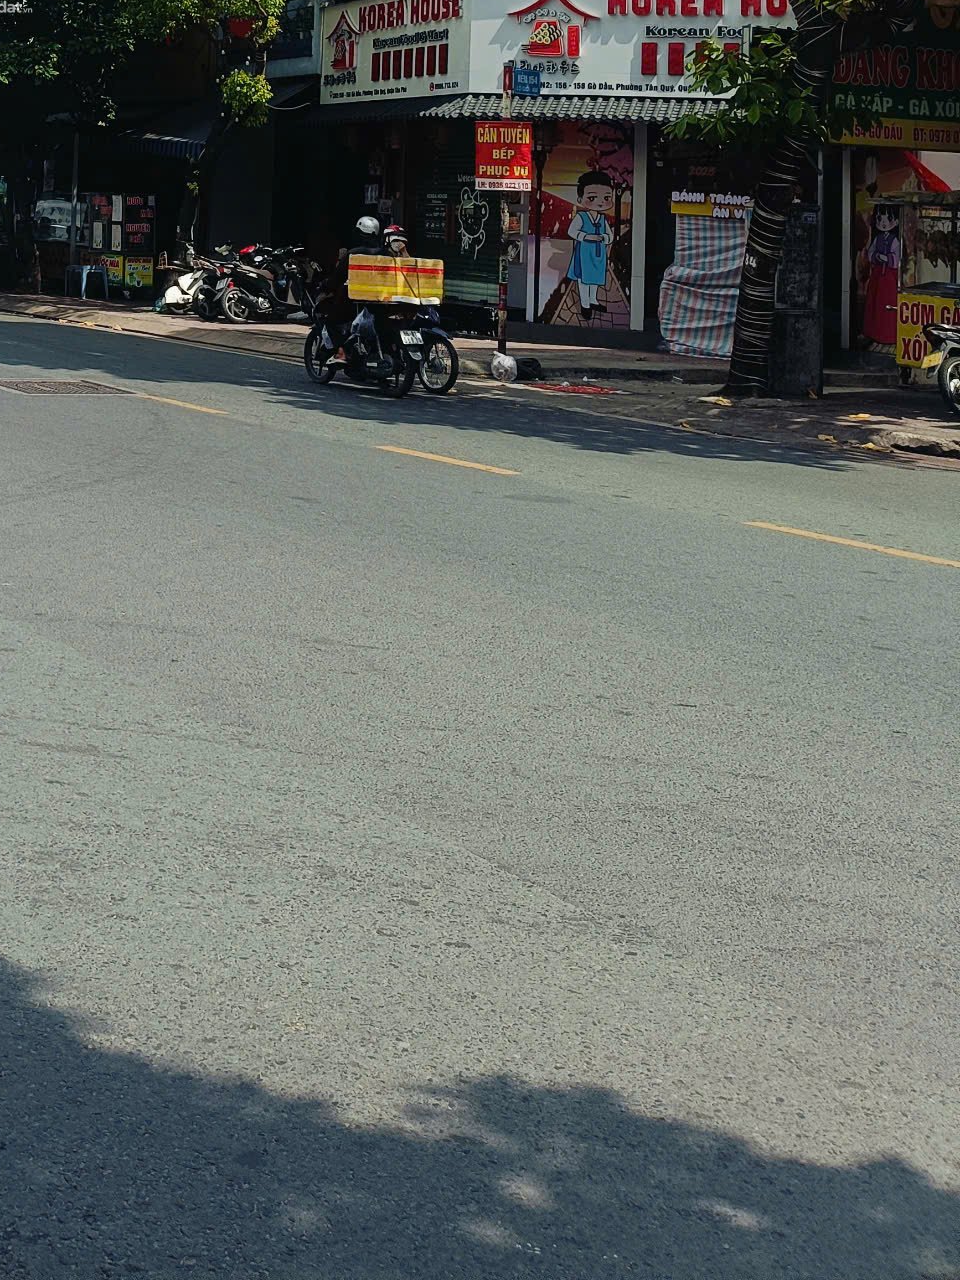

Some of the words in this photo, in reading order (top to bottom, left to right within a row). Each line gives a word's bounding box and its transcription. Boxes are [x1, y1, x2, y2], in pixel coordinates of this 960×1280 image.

[358, 0, 408, 34] KOREA
[645, 25, 710, 38] Korean
[909, 96, 930, 116] GÀ
[492, 146, 515, 159] BẾP
[479, 165, 510, 178] PHỤC
[513, 166, 528, 178] VỤ
[671, 188, 705, 203] BÁNH
[900, 301, 935, 326] CƠM
